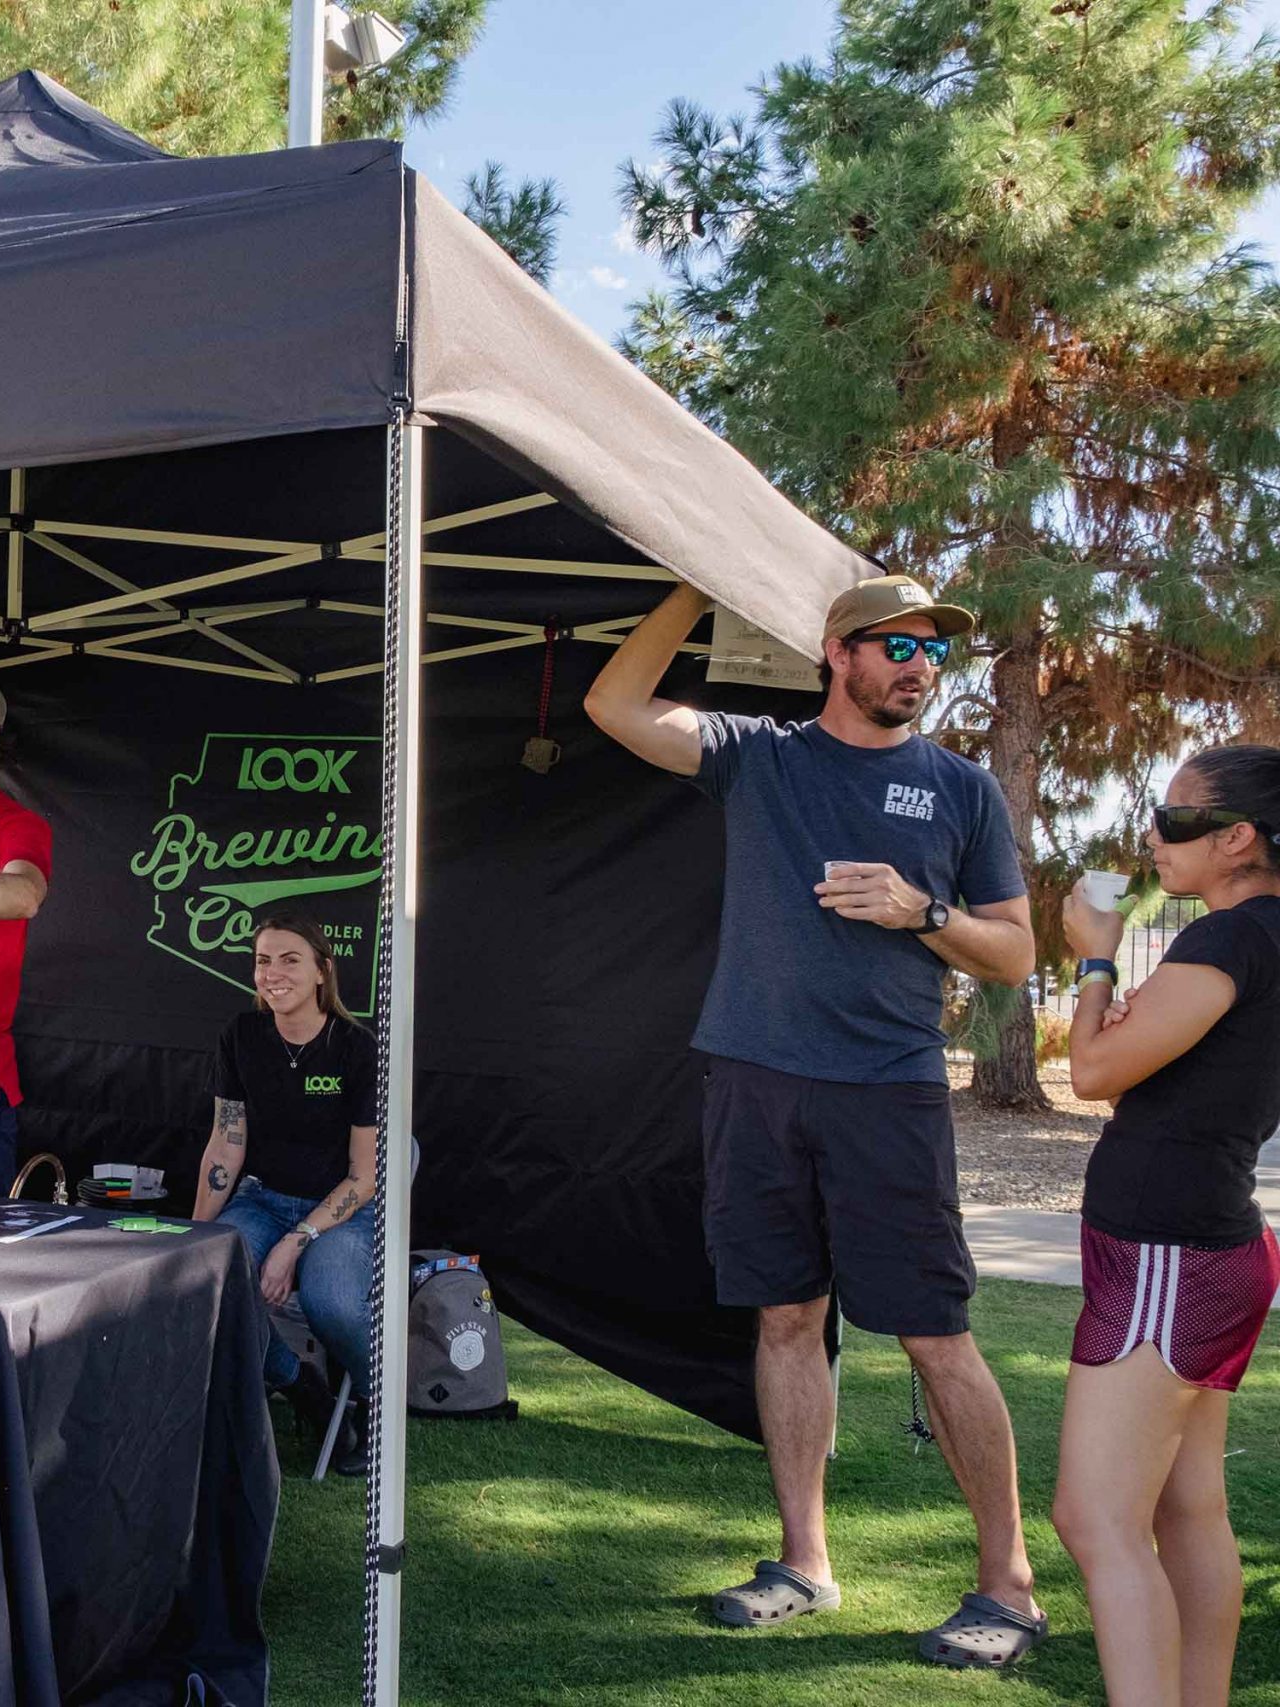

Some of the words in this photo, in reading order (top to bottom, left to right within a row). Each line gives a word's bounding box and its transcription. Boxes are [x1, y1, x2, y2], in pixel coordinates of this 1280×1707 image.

[237, 747, 358, 794] LOOK
[886, 783, 936, 808] PHX
[884, 800, 927, 820] BEER
[319, 924, 363, 939] DLER
[305, 1076, 342, 1091] LOOK
[446, 1323, 466, 1341] FIVE
[467, 1321, 487, 1338] STAR
